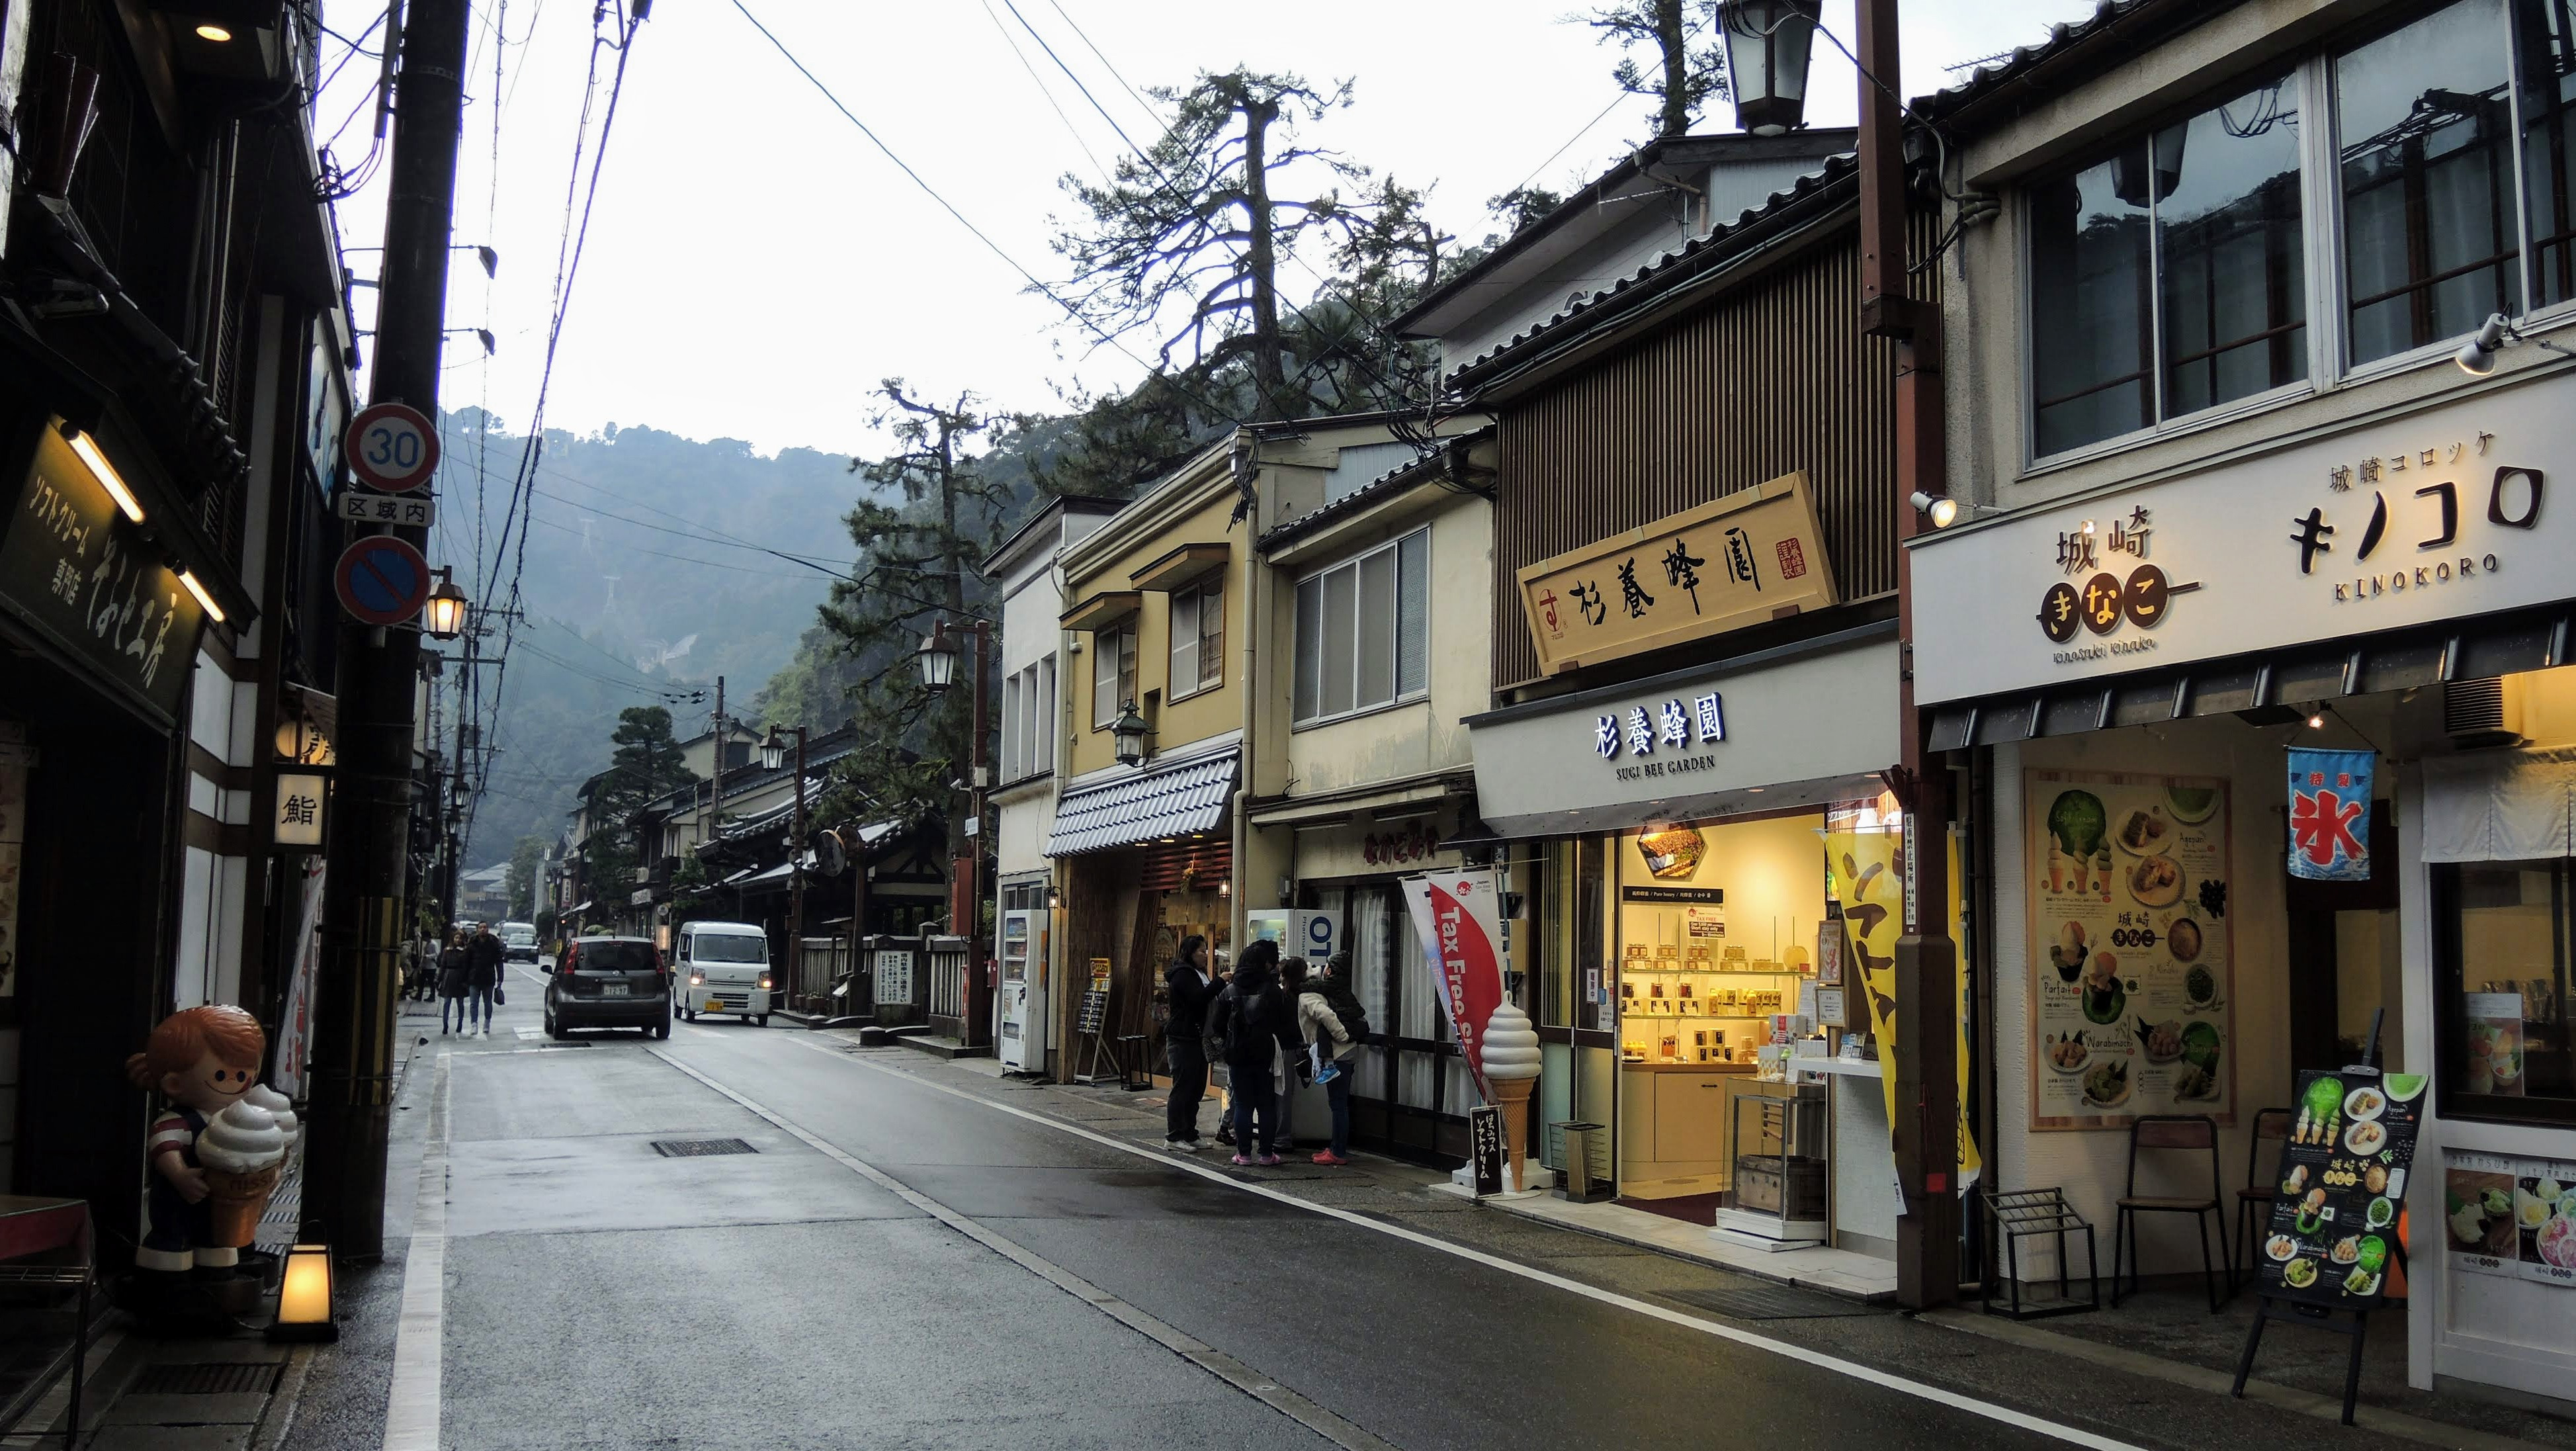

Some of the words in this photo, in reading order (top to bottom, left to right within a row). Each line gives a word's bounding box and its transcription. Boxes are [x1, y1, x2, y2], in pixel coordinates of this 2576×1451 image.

[368, 427, 419, 468] 30
[2329, 430, 2494, 491] 城崎コロッケ
[29, 475, 90, 558] ソフトクリーム
[347, 498, 425, 523] 区域内
[2290, 465, 2545, 574] キノコロ
[2055, 504, 2149, 575] 城崎
[52, 556, 82, 607] 専門店
[1568, 527, 1762, 627] 杉養蜂園
[2335, 553, 2497, 600] KINOKORO
[2049, 578, 2155, 635] きなこ
[1594, 691, 1726, 760] 杉養蜂園
[1616, 764, 1640, 781] SUGI
[1645, 761, 1664, 777] BEE
[1667, 755, 1716, 773] GARDEN
[280, 795, 318, 826] 鮨
[2291, 791, 2366, 865] 氷
[1441, 906, 1461, 953] Tax
[2118, 910, 2150, 927] 城崎
[1446, 959, 1466, 1016] Free
[2044, 981, 2071, 994] Parfait
[1476, 1118, 1490, 1179] ソフトクリーム
[2331, 1158, 2356, 1171] 城崎
